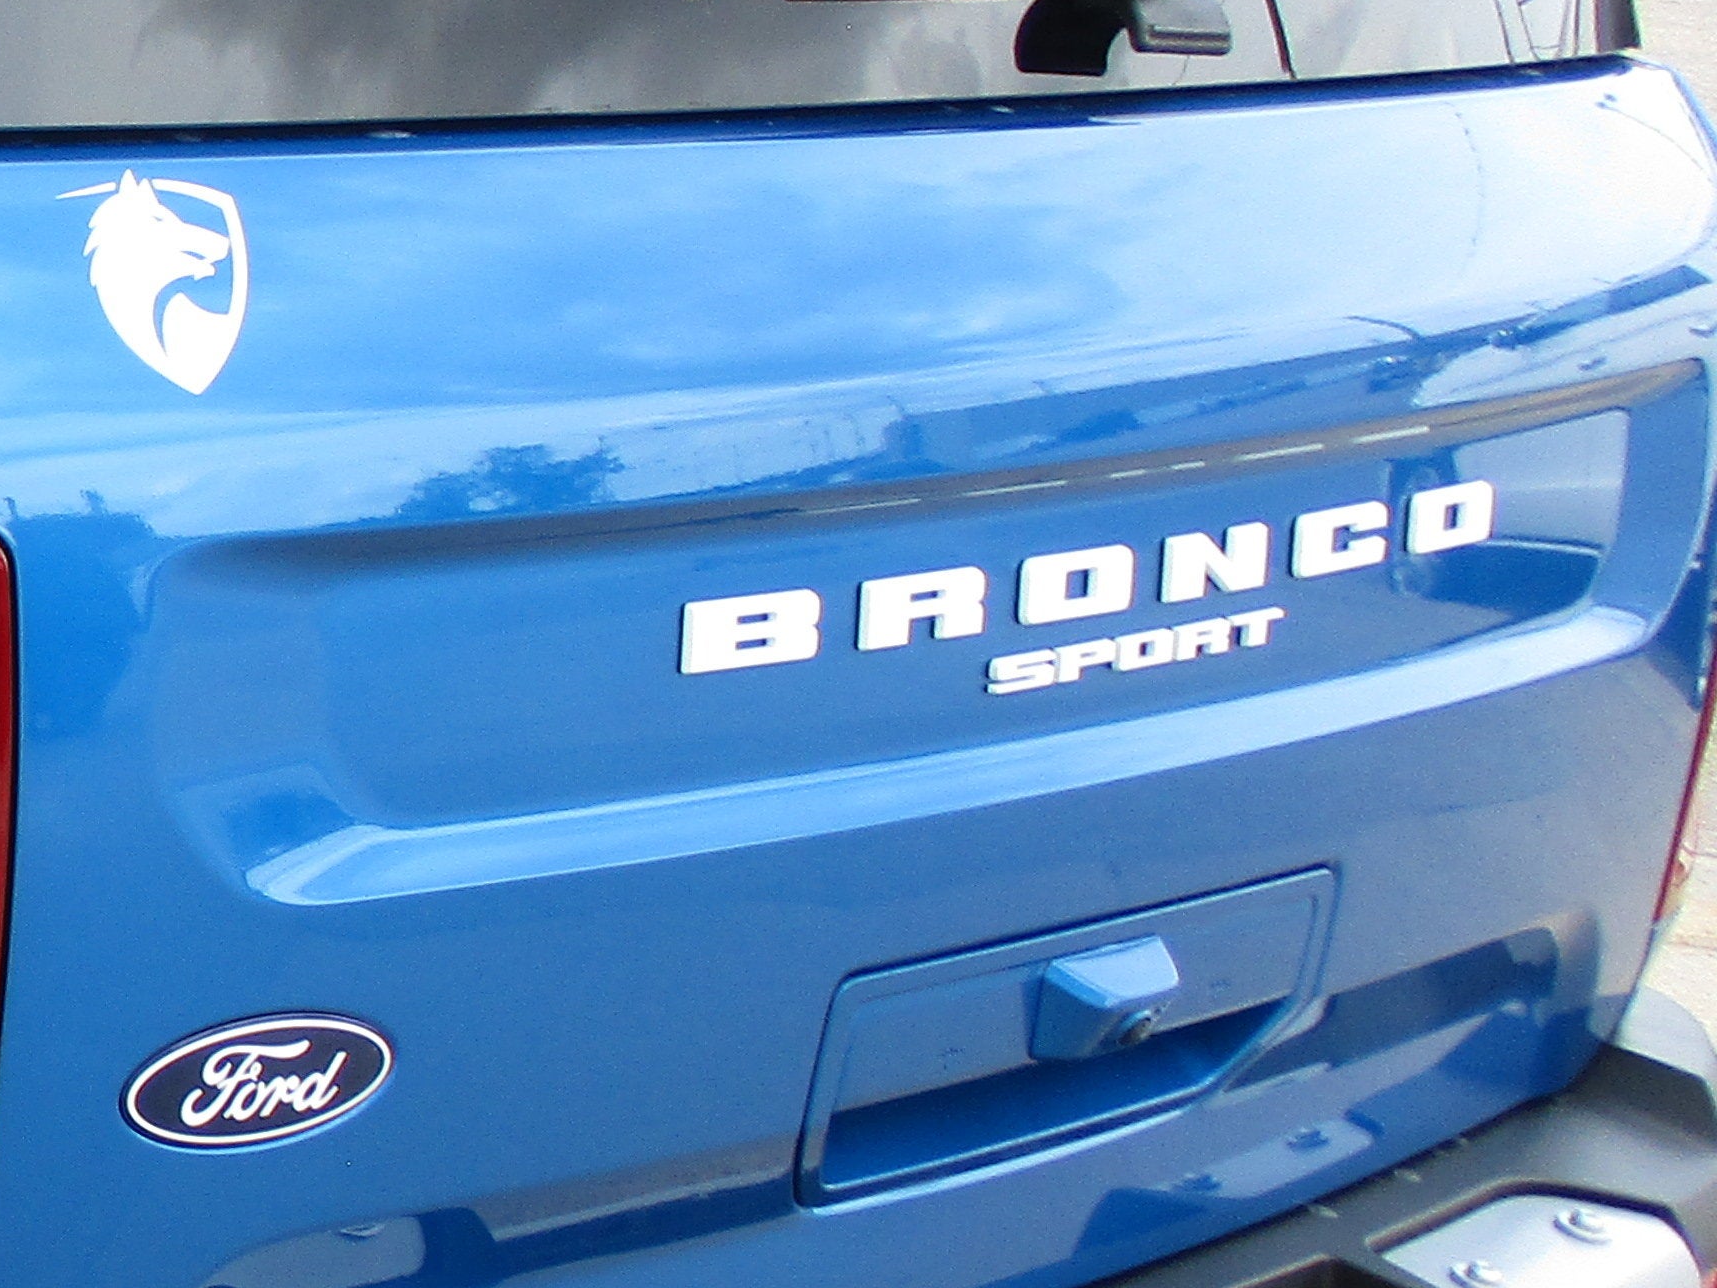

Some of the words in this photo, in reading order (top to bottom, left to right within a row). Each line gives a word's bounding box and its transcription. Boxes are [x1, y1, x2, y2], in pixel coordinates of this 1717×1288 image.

[679, 479, 1494, 675] BRONCO
[986, 606, 1285, 696] SPORT
[181, 1039, 348, 1127] Ford
